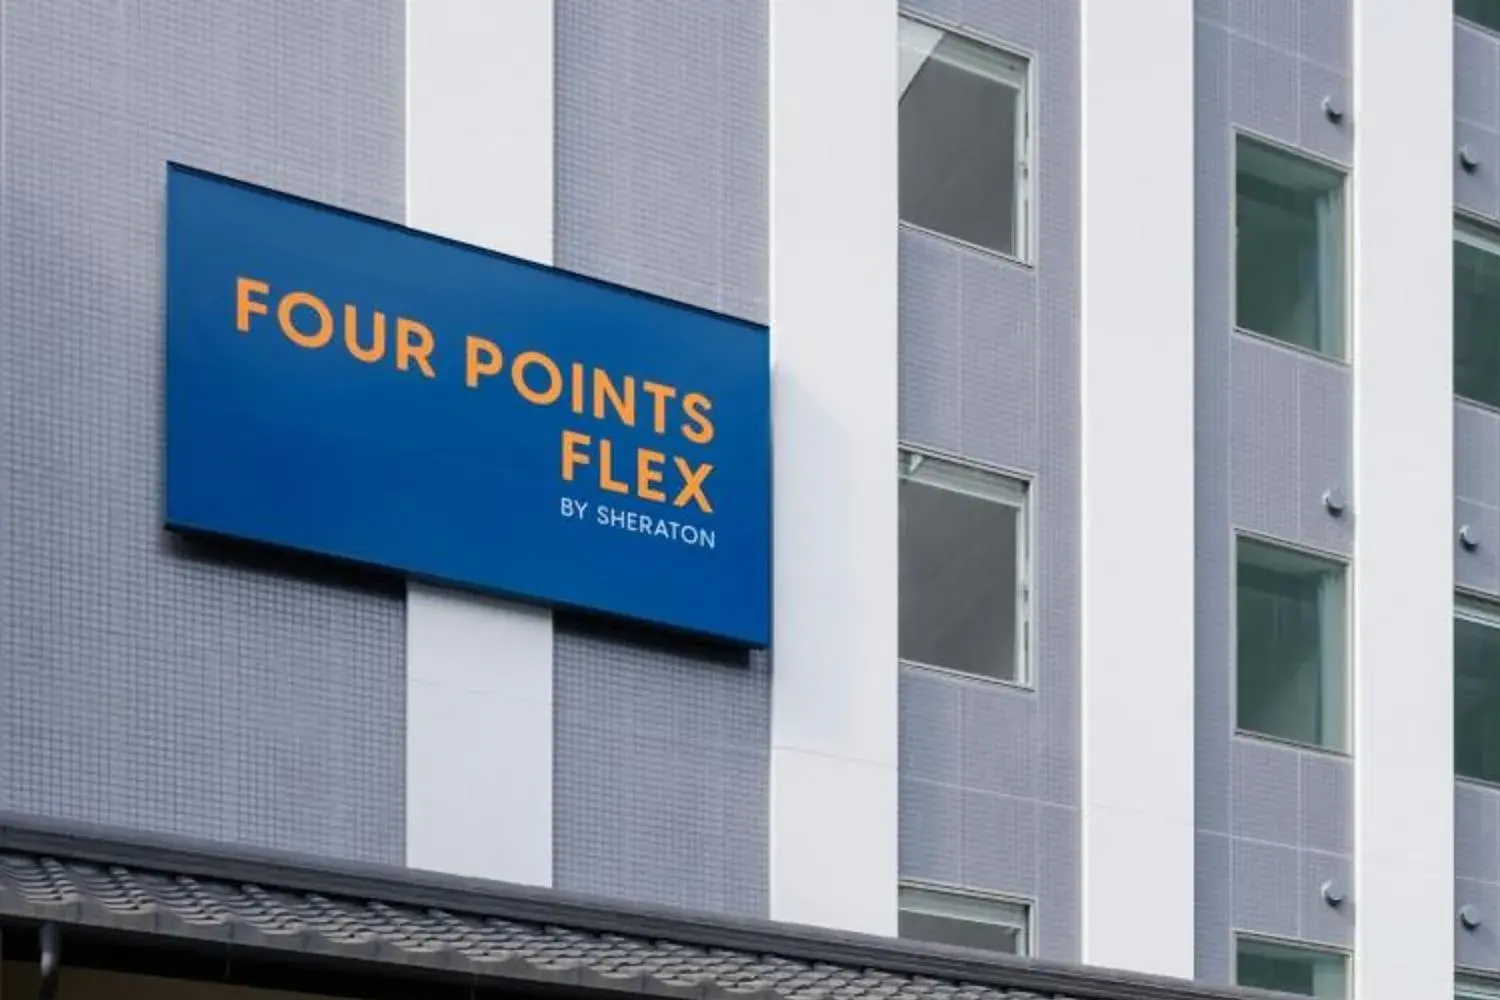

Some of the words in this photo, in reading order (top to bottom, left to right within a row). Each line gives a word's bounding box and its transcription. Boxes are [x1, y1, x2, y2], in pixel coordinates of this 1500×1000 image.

[236, 278, 435, 377] FOUR
[466, 335, 715, 444] POINTS
[562, 430, 713, 513] FLEX
[560, 497, 588, 519] BY
[597, 505, 716, 549] SHERATON
